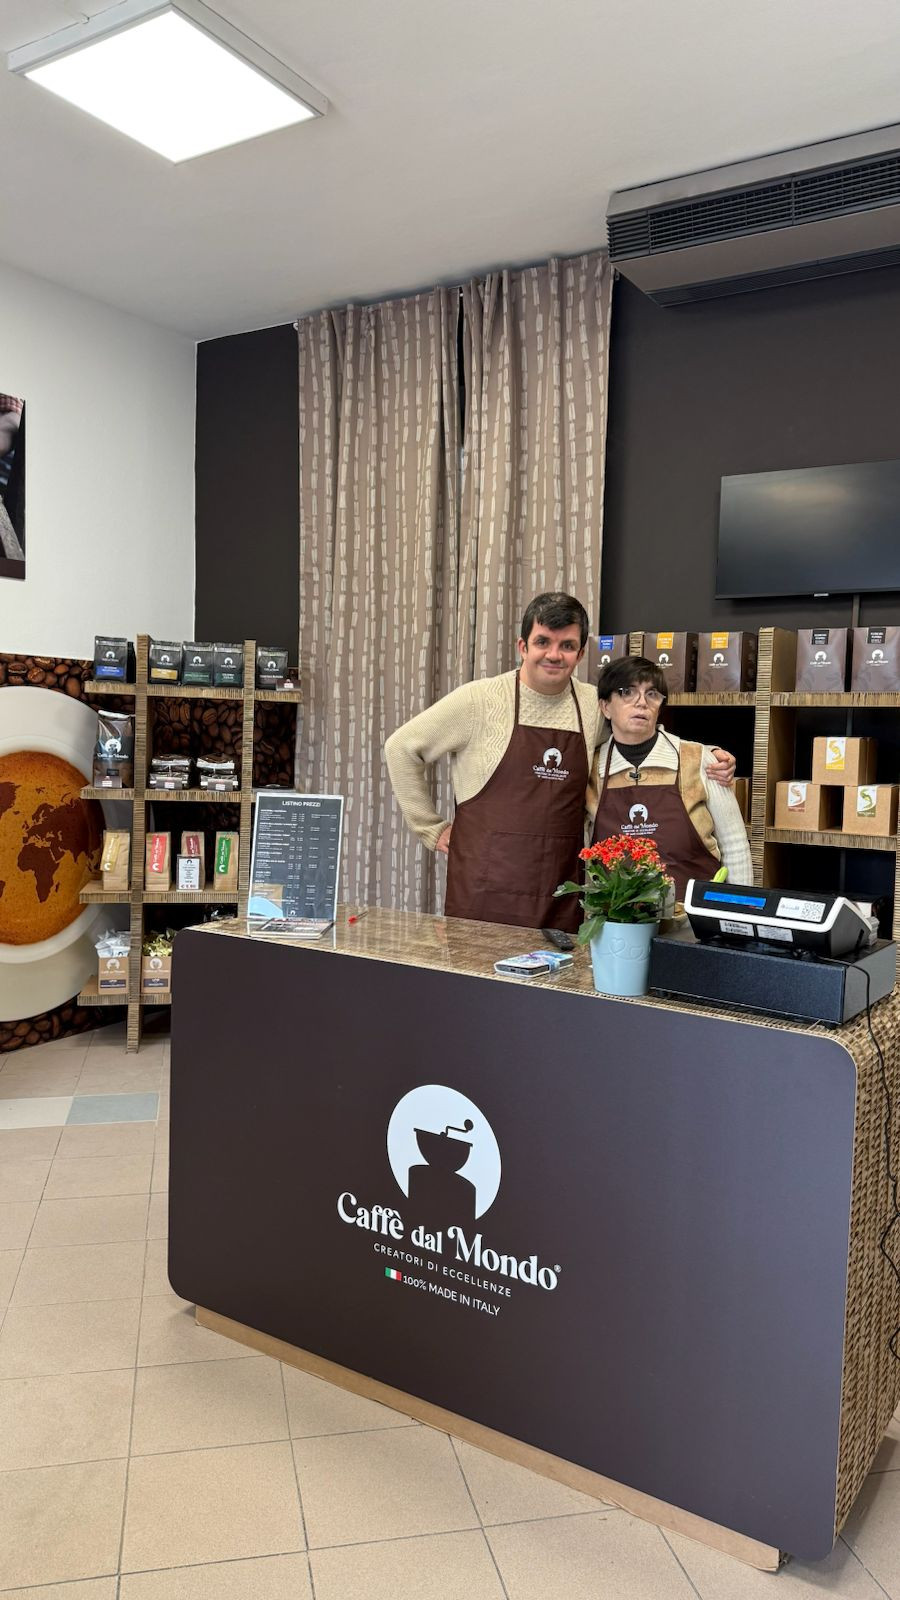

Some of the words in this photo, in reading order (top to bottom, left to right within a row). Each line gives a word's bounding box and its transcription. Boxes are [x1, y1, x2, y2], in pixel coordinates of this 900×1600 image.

[337, 1191, 404, 1240] Caffè
[411, 1225, 443, 1254] dal
[373, 1242, 423, 1267] CREATORI
[427, 1260, 438, 1272] DI
[442, 1266, 511, 1297] ECCELLENZE
[403, 1275, 426, 1291] 100%
[428, 1282, 457, 1302] MADE
[459, 1293, 470, 1306] IN
[472, 1298, 500, 1317] ITALY
